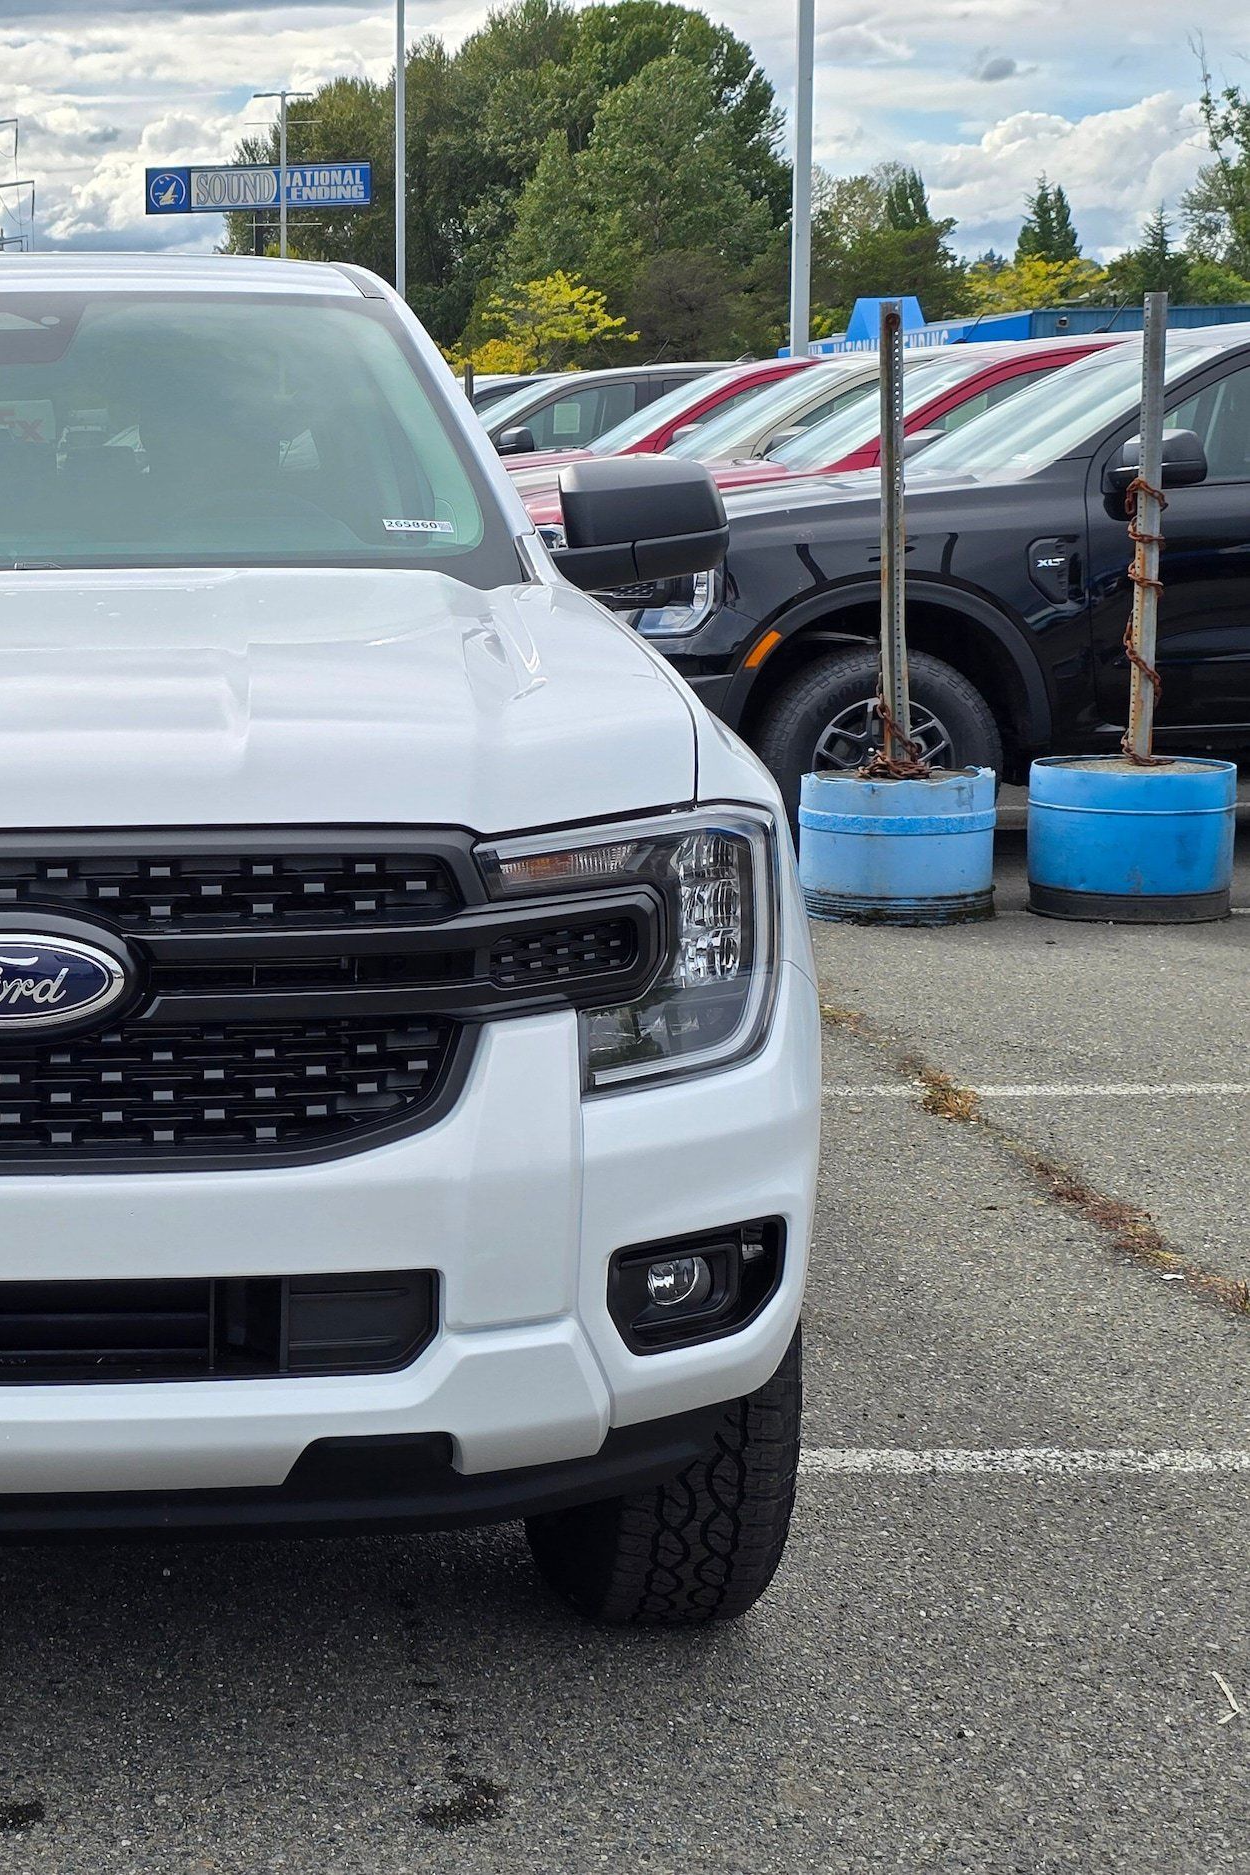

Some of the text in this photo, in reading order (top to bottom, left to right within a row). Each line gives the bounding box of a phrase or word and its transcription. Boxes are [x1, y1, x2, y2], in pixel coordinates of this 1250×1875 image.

[196, 173, 275, 205] SOUND
[284, 185, 365, 205] ENDING
[385, 520, 438, 529] 265860
[1036, 557, 1066, 568] XLT
